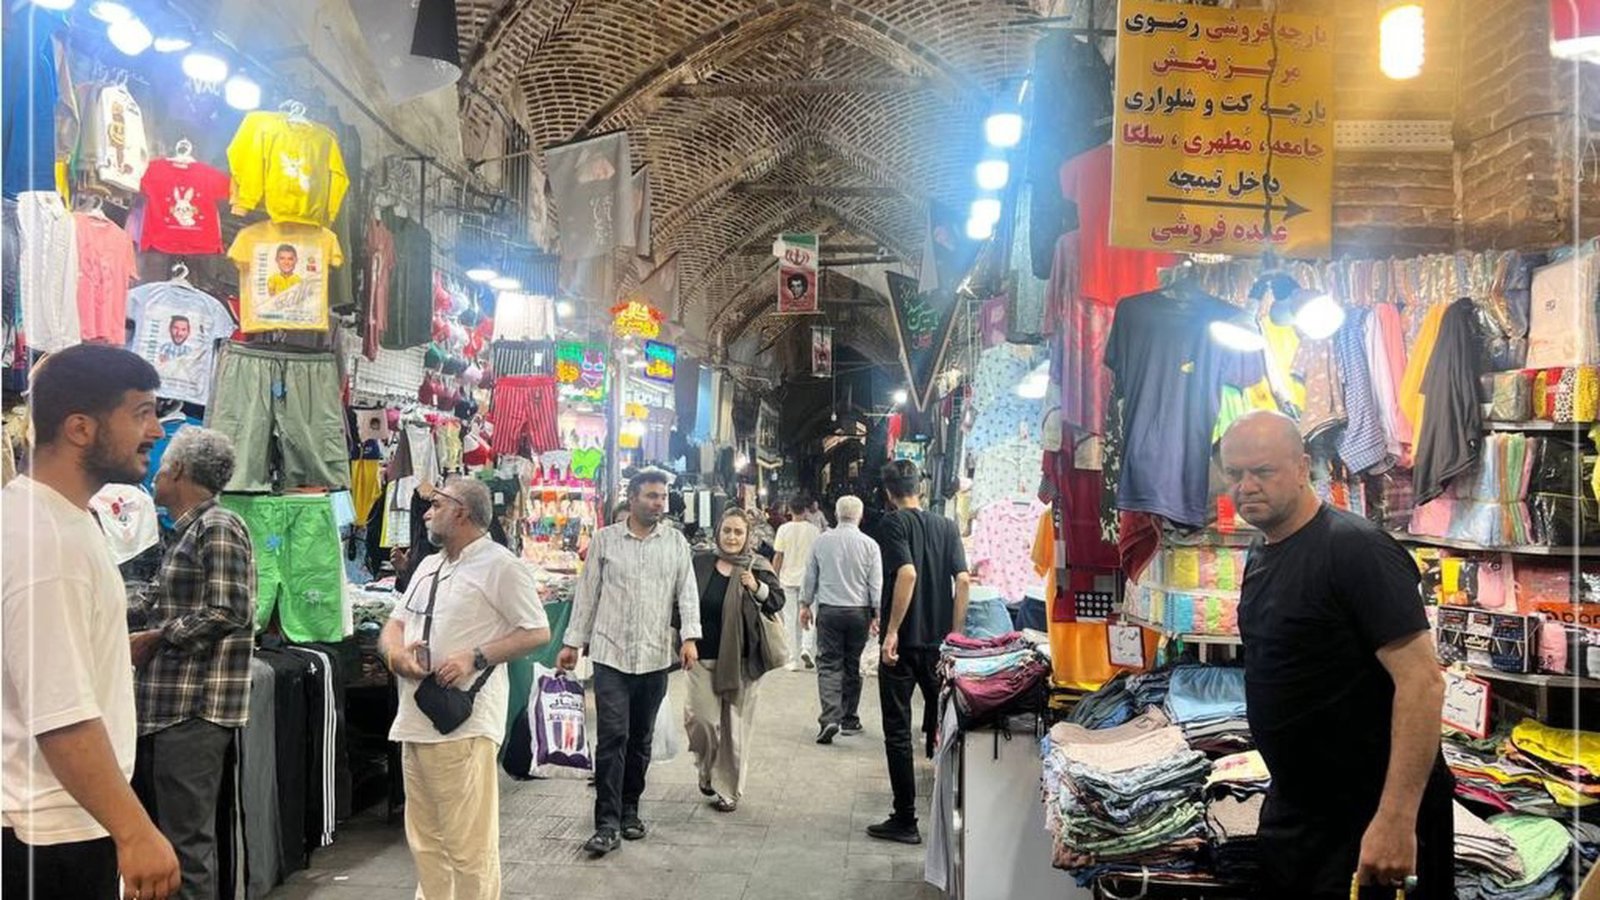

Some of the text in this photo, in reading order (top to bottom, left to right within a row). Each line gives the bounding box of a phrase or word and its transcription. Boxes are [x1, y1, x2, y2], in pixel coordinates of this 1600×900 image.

[1125, 11, 1200, 38] رضوی
[1206, 16, 1273, 43] فروشی
[1153, 47, 1218, 79] پخش
[1124, 86, 1196, 114] شلواری
[1203, 99, 1214, 116] و
[1220, 93, 1253, 112] کت
[1169, 169, 1280, 196] داخل تیمچه
[1151, 213, 1288, 244] عده فروشی
